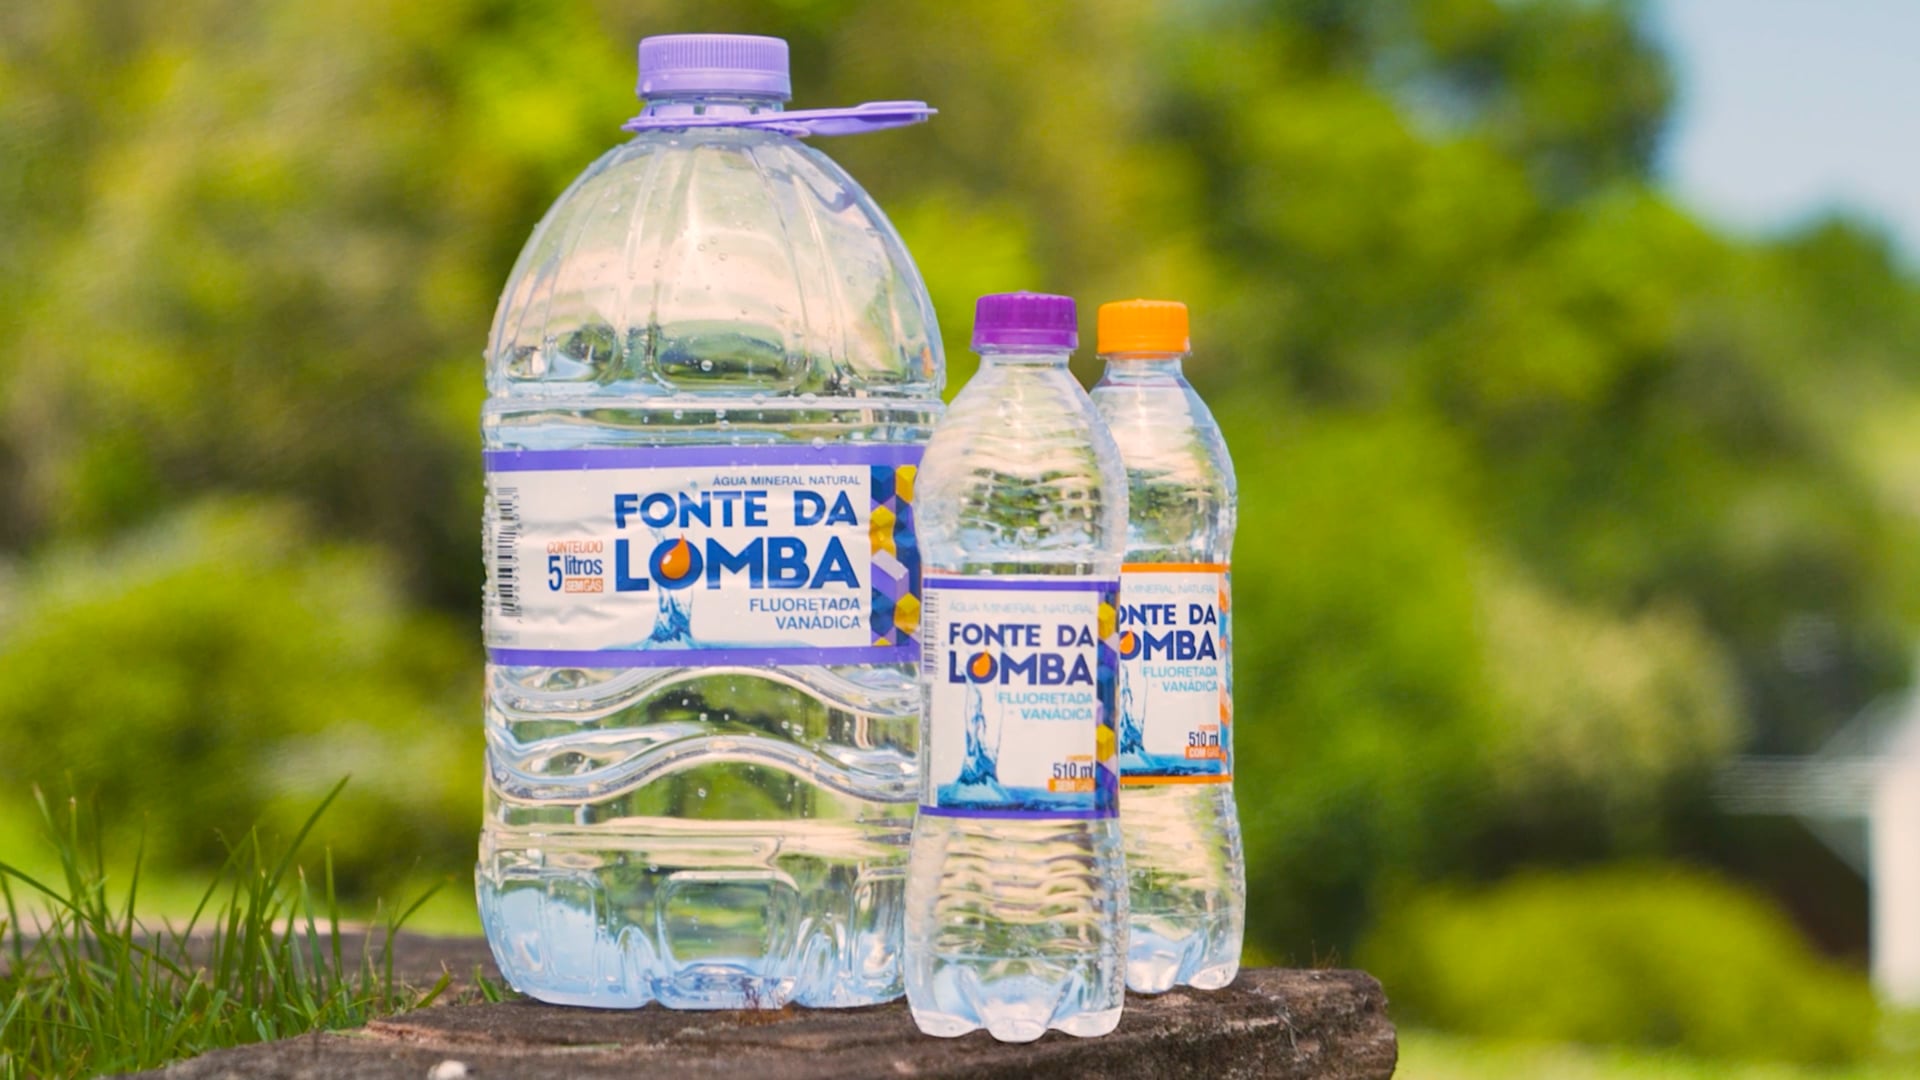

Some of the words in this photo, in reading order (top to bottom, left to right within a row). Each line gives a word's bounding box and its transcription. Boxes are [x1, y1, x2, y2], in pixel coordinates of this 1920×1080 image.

[713, 474, 747, 486] ÁGUA
[751, 475, 804, 486] MINERAL
[809, 475, 861, 486] NATURAL
[614, 490, 768, 529] FONTE
[794, 490, 859, 527] DA
[548, 555, 563, 592] 5
[564, 554, 603, 576] litros
[615, 534, 860, 592] LOMBA
[749, 598, 861, 612] FLUORETADA
[1188, 604, 1217, 625] DA
[775, 611, 861, 630] VANÁDICA
[949, 622, 1041, 647] FONTE
[1057, 624, 1095, 647] DA
[1119, 629, 1217, 661] OMBA
[948, 649, 1094, 685] LOMBA
[1143, 666, 1217, 678] FLUORETADA
[997, 692, 1093, 705] FLUORETADA
[1188, 731, 1207, 747] 510
[1053, 762, 1077, 779] 510
[1080, 761, 1094, 779] ml
